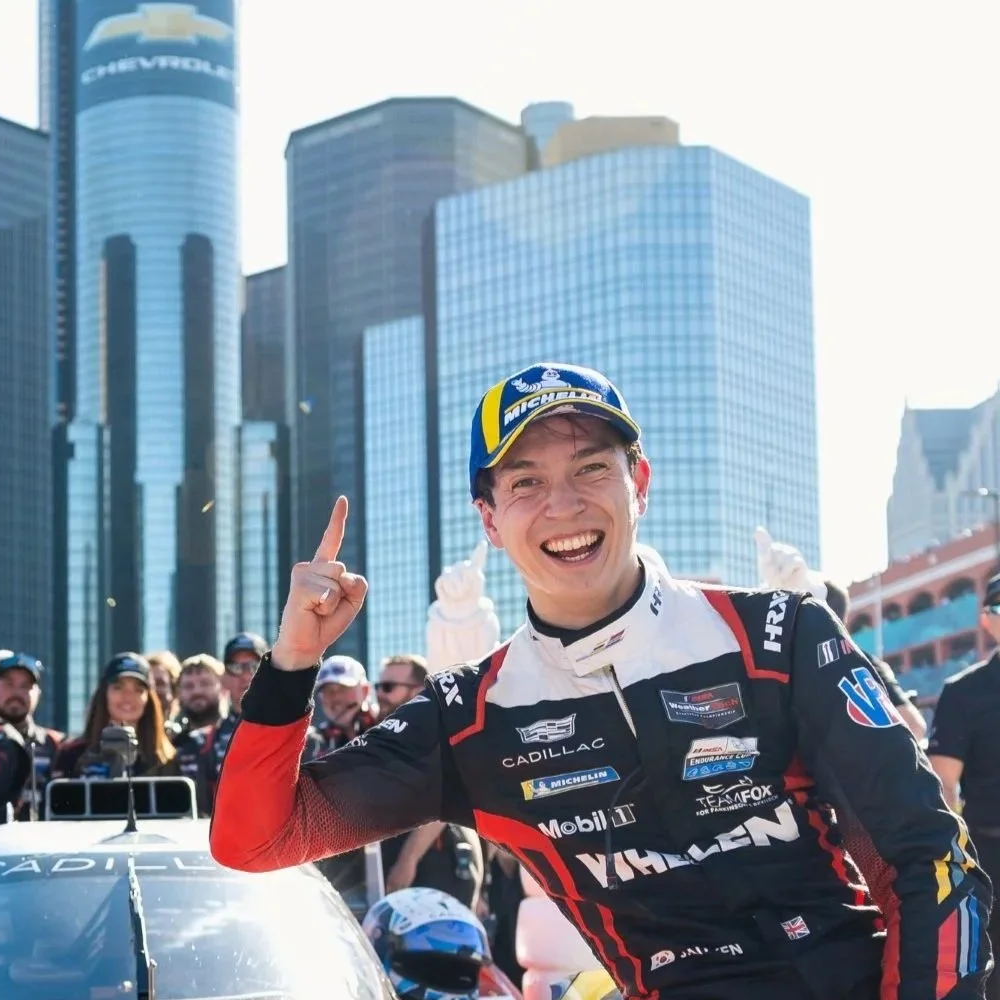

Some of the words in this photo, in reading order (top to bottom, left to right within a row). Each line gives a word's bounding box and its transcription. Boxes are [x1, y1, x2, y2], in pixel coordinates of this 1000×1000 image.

[81, 55, 234, 85] CHEVROLE
[763, 590, 790, 653] HRX
[502, 737, 605, 768] CADILLAC
[550, 771, 608, 789] MICHELIN
[695, 784, 773, 809] TEAMFOX
[537, 809, 608, 840] Mobil
